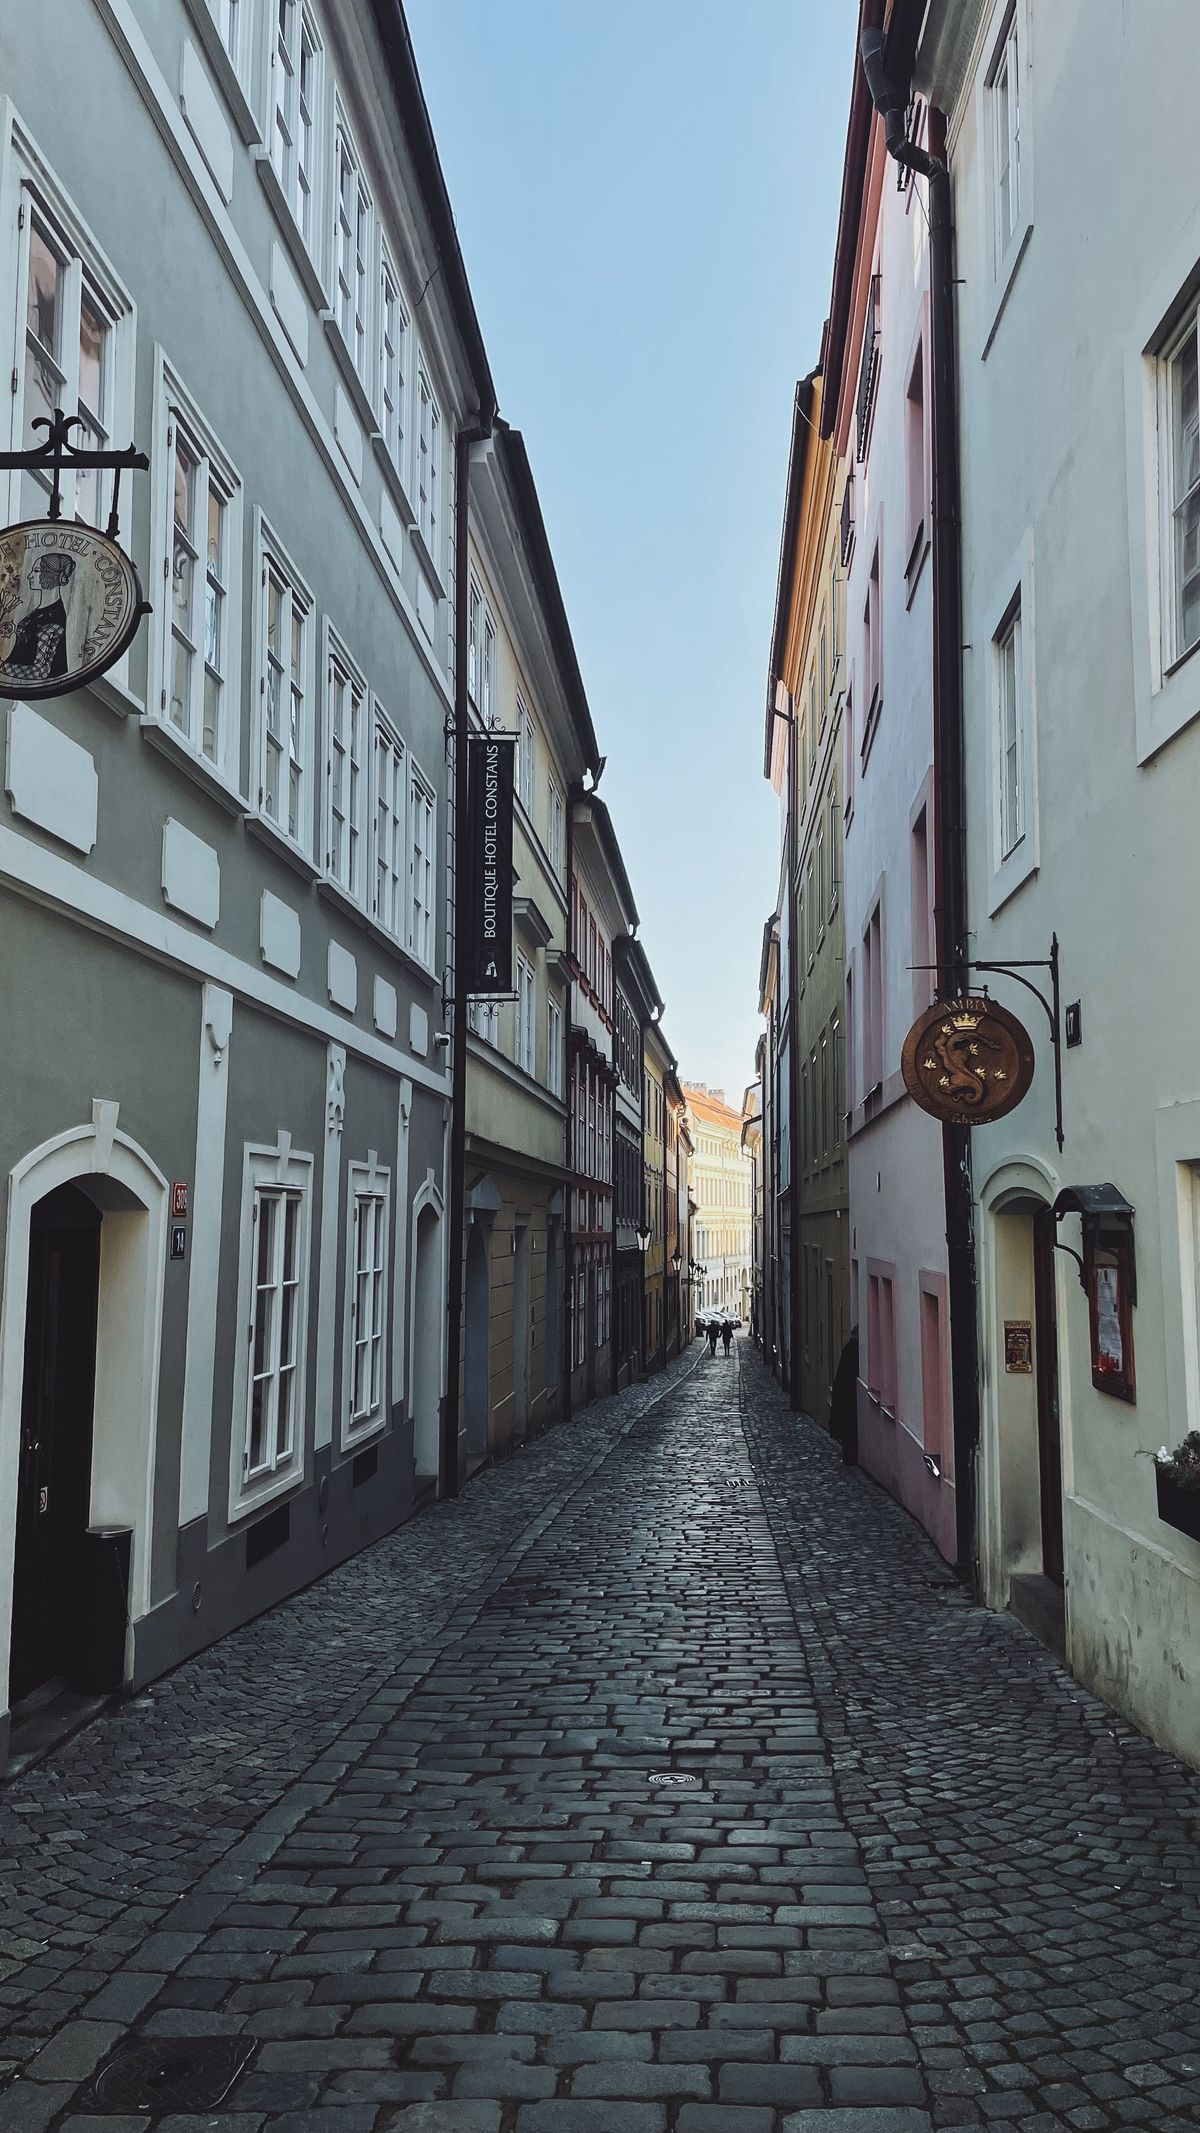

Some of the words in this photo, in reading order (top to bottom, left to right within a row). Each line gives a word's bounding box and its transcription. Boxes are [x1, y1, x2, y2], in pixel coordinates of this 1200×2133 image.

[25, 532, 92, 556] HOTEL
[80, 554, 122, 655] CONSTANS
[485, 745, 498, 818] CONSTANS
[485, 822, 497, 865] HOTEL
[484, 869, 498, 938] BOUTIQUE
[177, 1233, 184, 1251] 14
